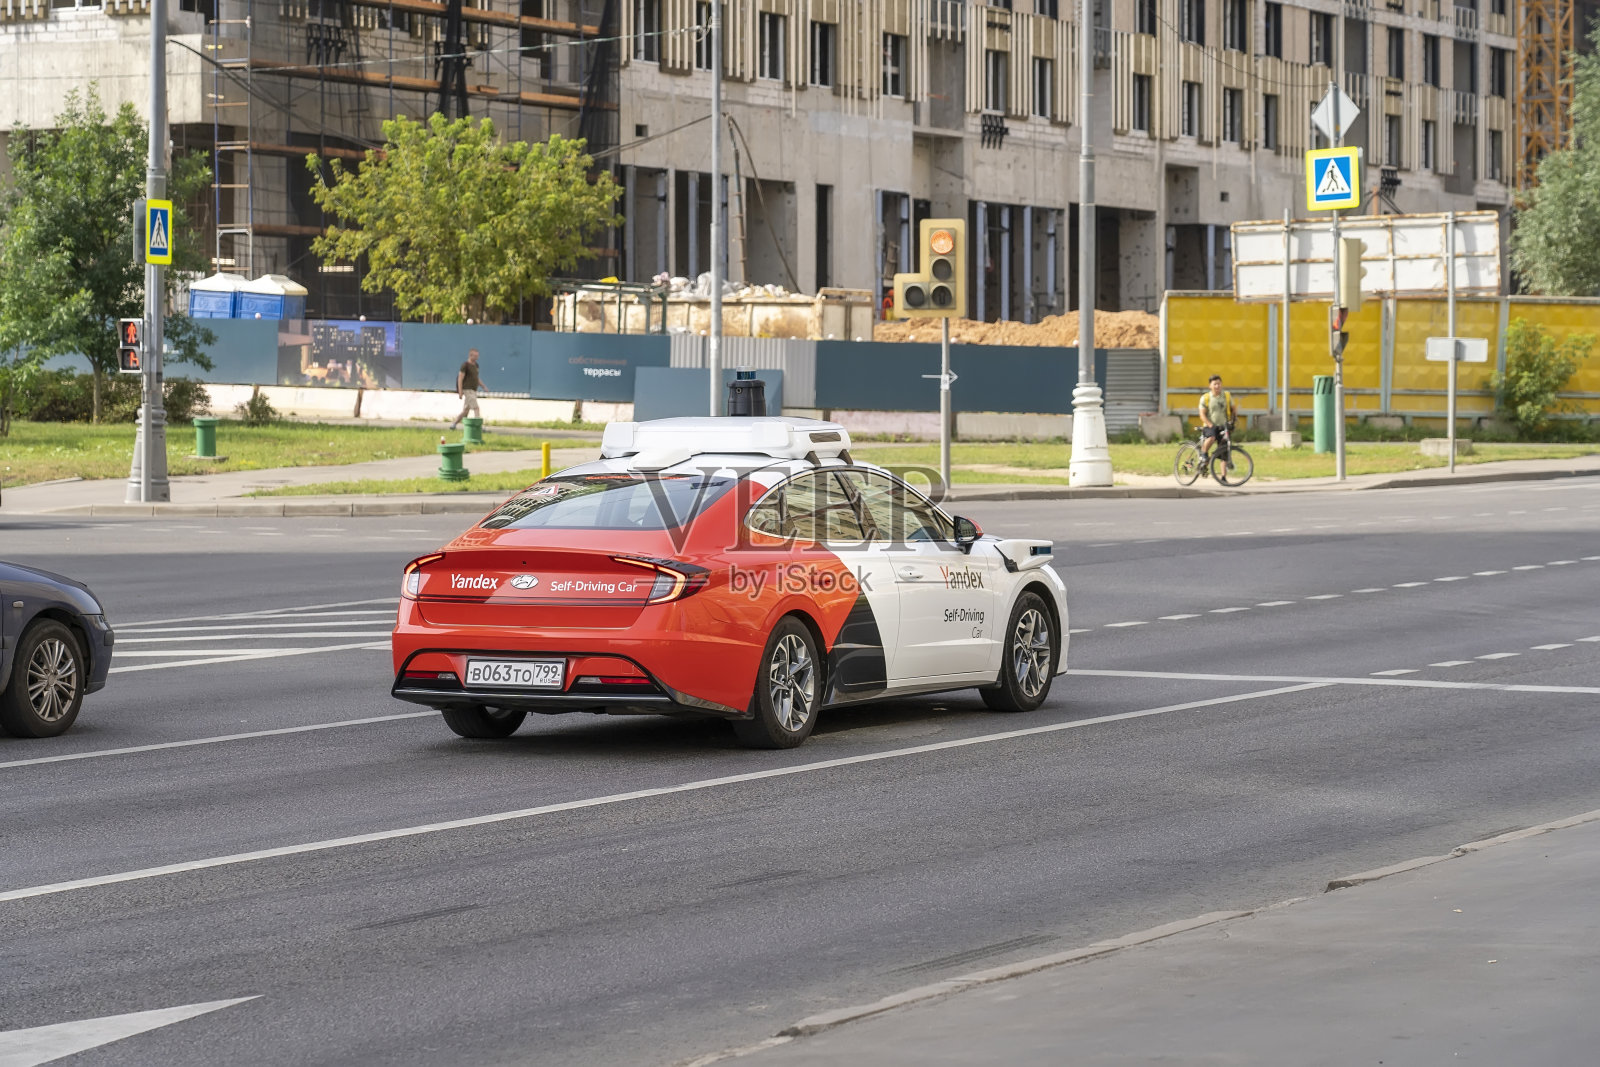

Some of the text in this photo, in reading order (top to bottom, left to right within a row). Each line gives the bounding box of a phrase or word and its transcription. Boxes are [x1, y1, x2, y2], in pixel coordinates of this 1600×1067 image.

[583, 367, 621, 377] террасы
[451, 574, 498, 589] Yandex
[939, 565, 984, 589] Yandex
[550, 581, 637, 593] Self-Driving Car
[944, 608, 985, 624] Self-Driving
[971, 626, 983, 638] Car
[535, 665, 558, 678] 799
